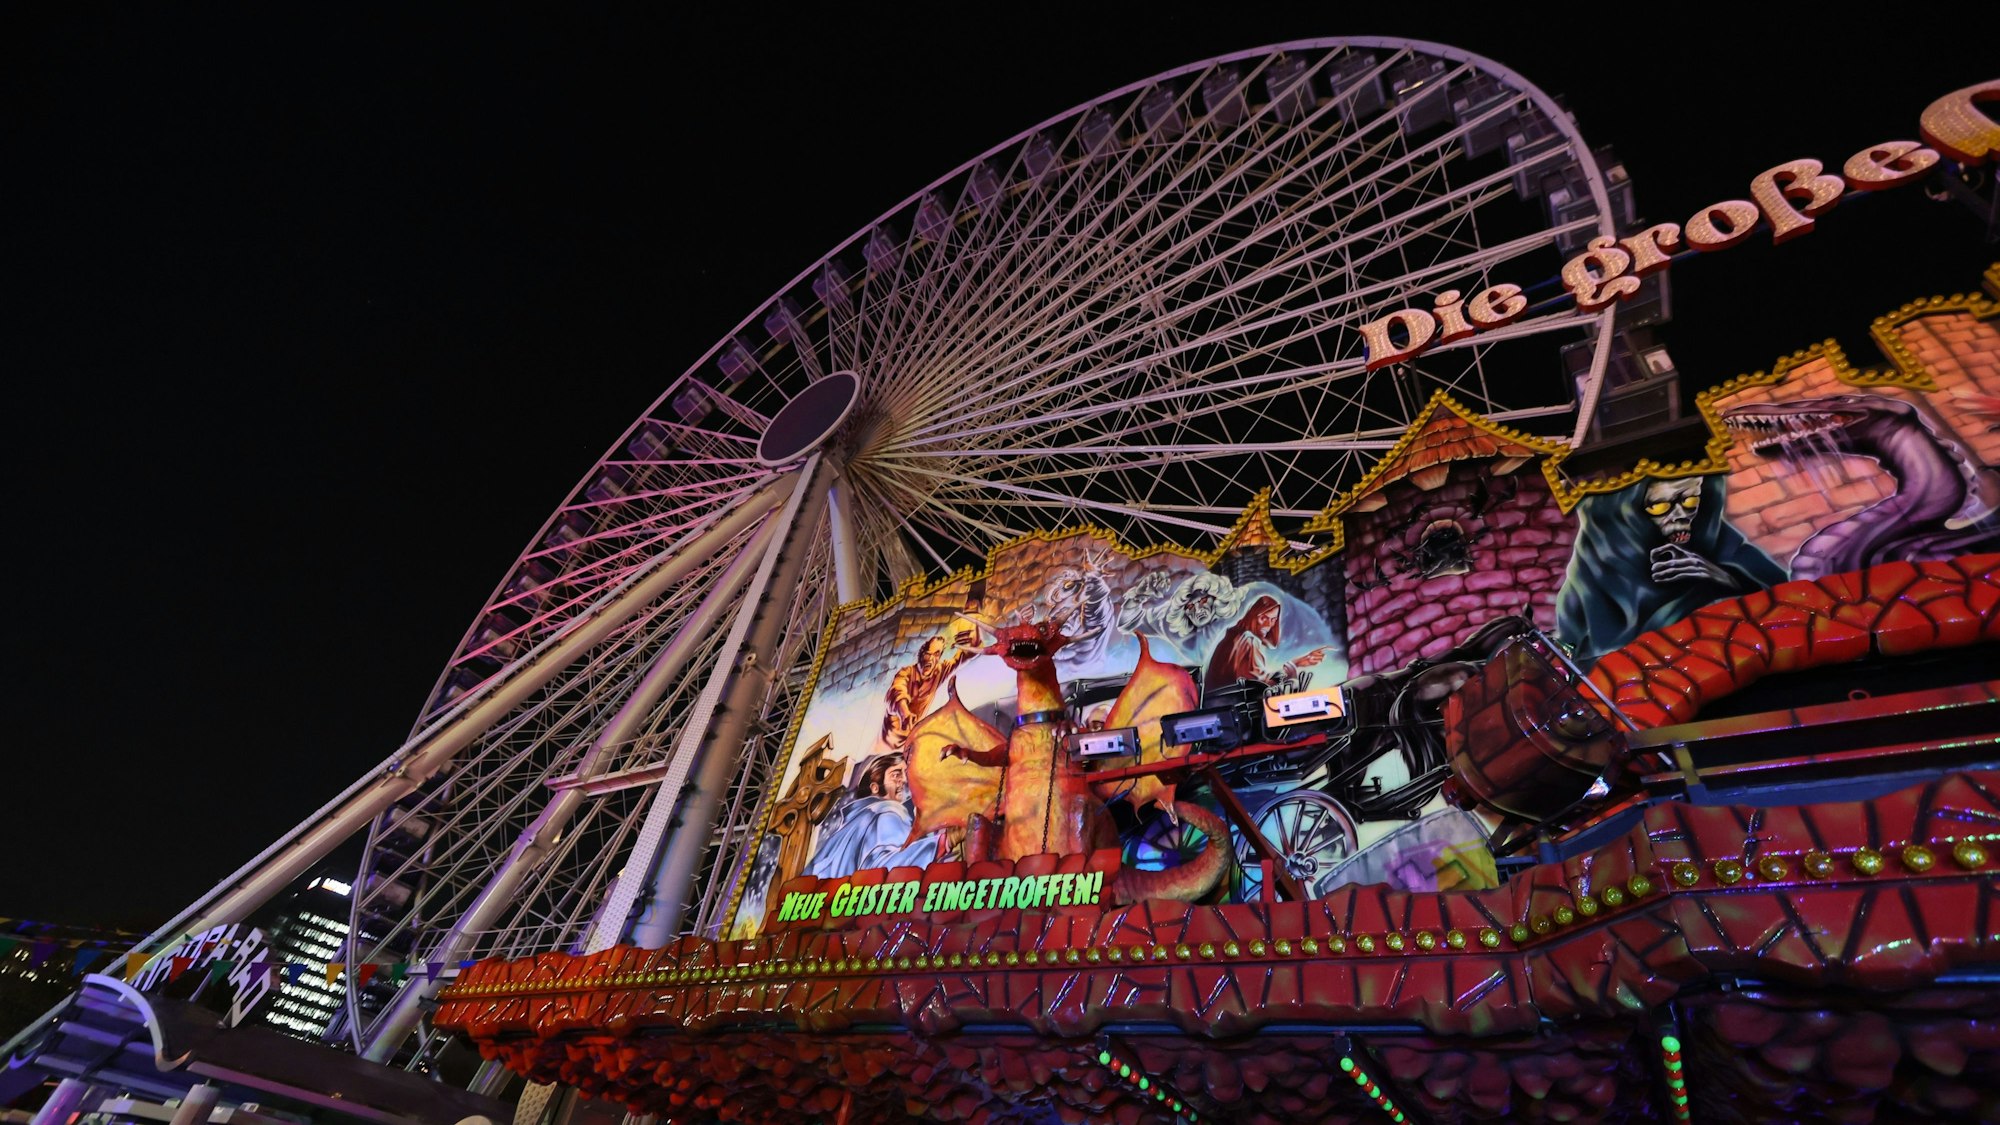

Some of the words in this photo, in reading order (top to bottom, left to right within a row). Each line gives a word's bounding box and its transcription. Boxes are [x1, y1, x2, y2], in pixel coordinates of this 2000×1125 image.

[1359, 282, 1527, 371] Die
[1561, 139, 1941, 312] große
[777, 892, 827, 922] NEUE
[829, 880, 921, 918] GEISTER
[922, 871, 1104, 914] EINGETROFFEN!
